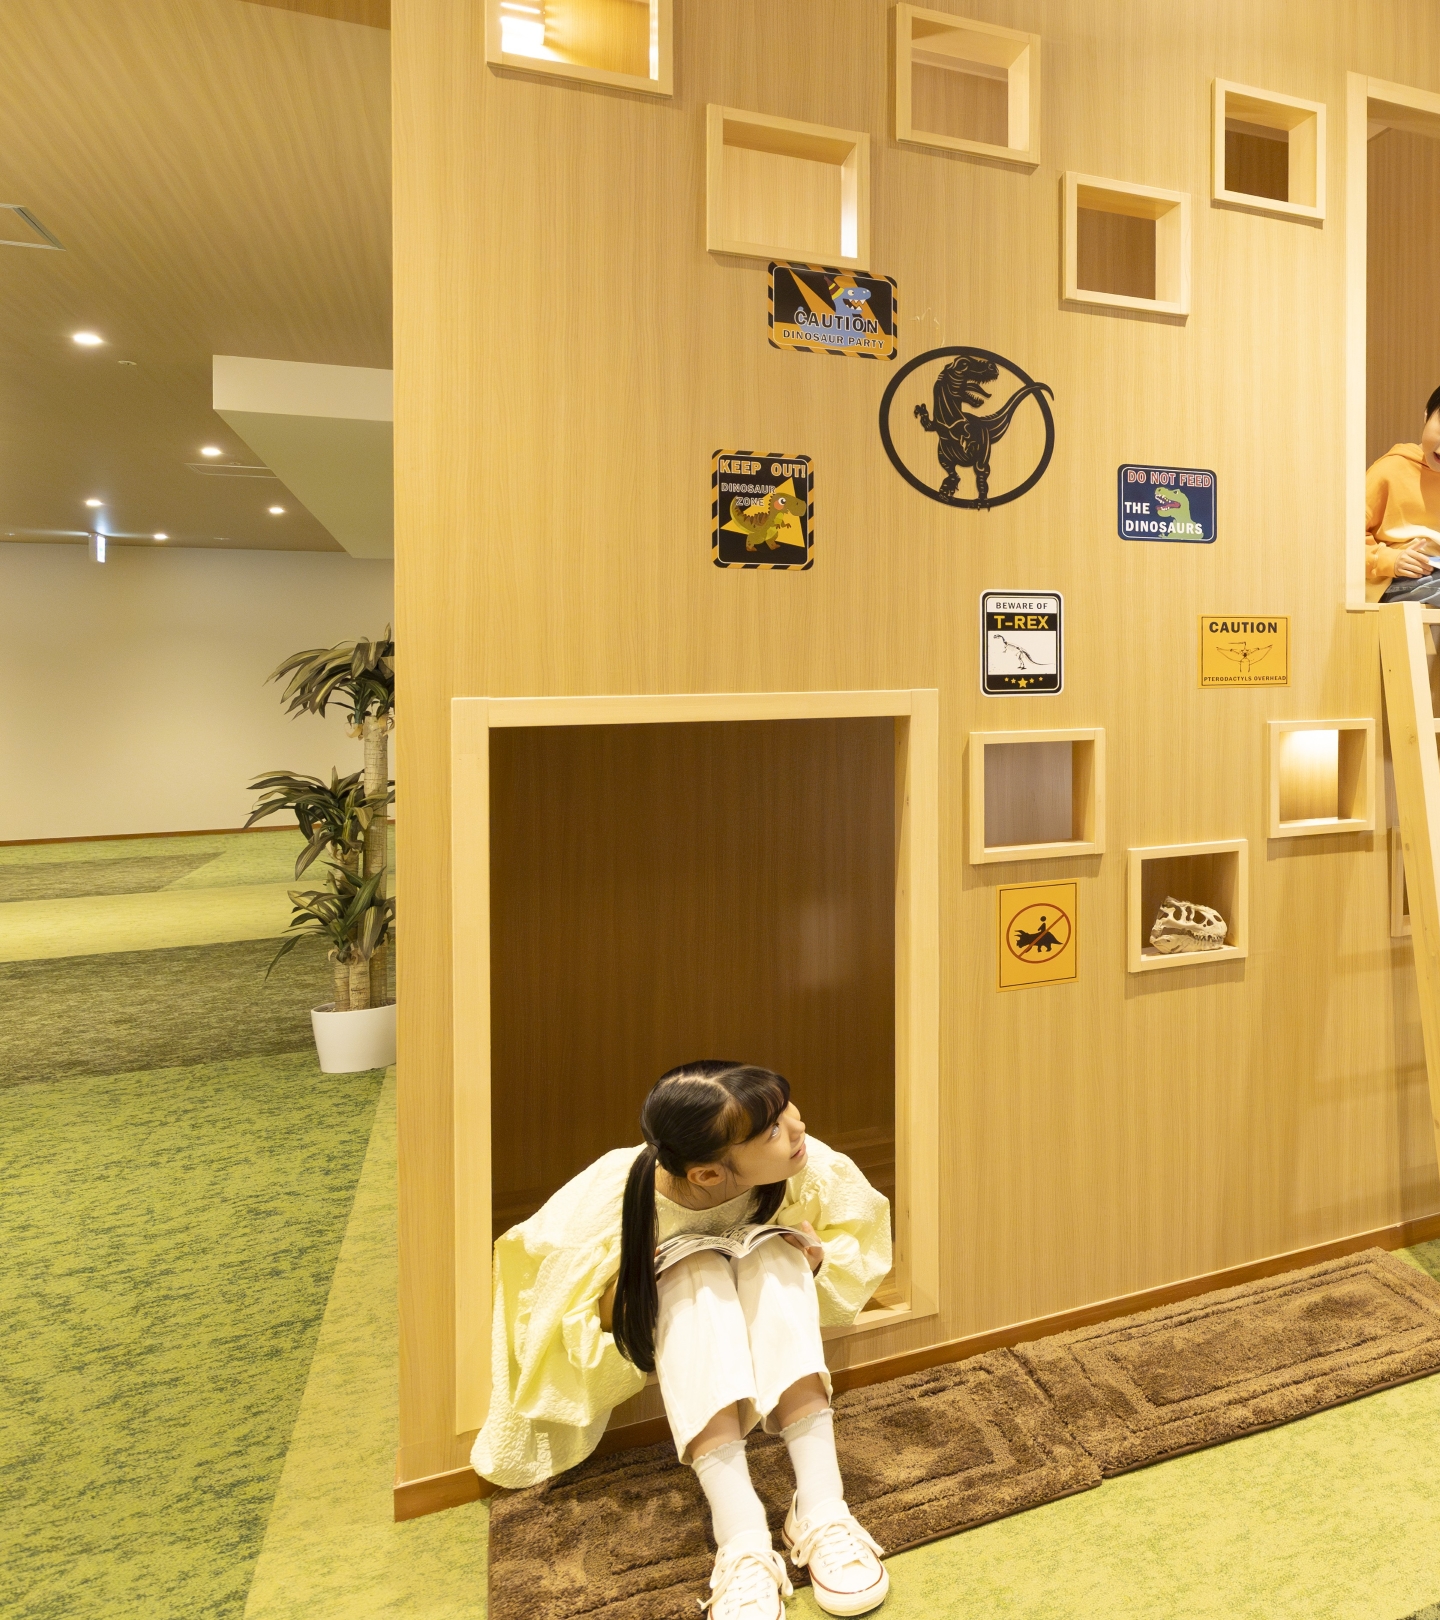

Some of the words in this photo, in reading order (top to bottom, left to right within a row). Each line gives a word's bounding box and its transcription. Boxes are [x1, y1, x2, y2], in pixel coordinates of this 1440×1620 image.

[794, 309, 879, 334] CAUTION
[783, 329, 845, 345] DINOSAUR
[848, 337, 885, 349] PARTY
[719, 459, 762, 475] KEEP
[770, 462, 806, 478] OUT!
[1127, 470, 1147, 483] DO
[1150, 471, 1177, 485] NOT
[1179, 473, 1212, 488] FEED
[720, 482, 777, 494] DINOSAUR
[735, 496, 765, 507] ZONE
[1124, 501, 1151, 515] THE
[1125, 519, 1203, 535] DINOSAURS
[995, 601, 1034, 610] BEWARE
[1036, 602, 1049, 610] OF
[993, 615, 1049, 630] T-REX
[1209, 621, 1278, 634] CAUTION
